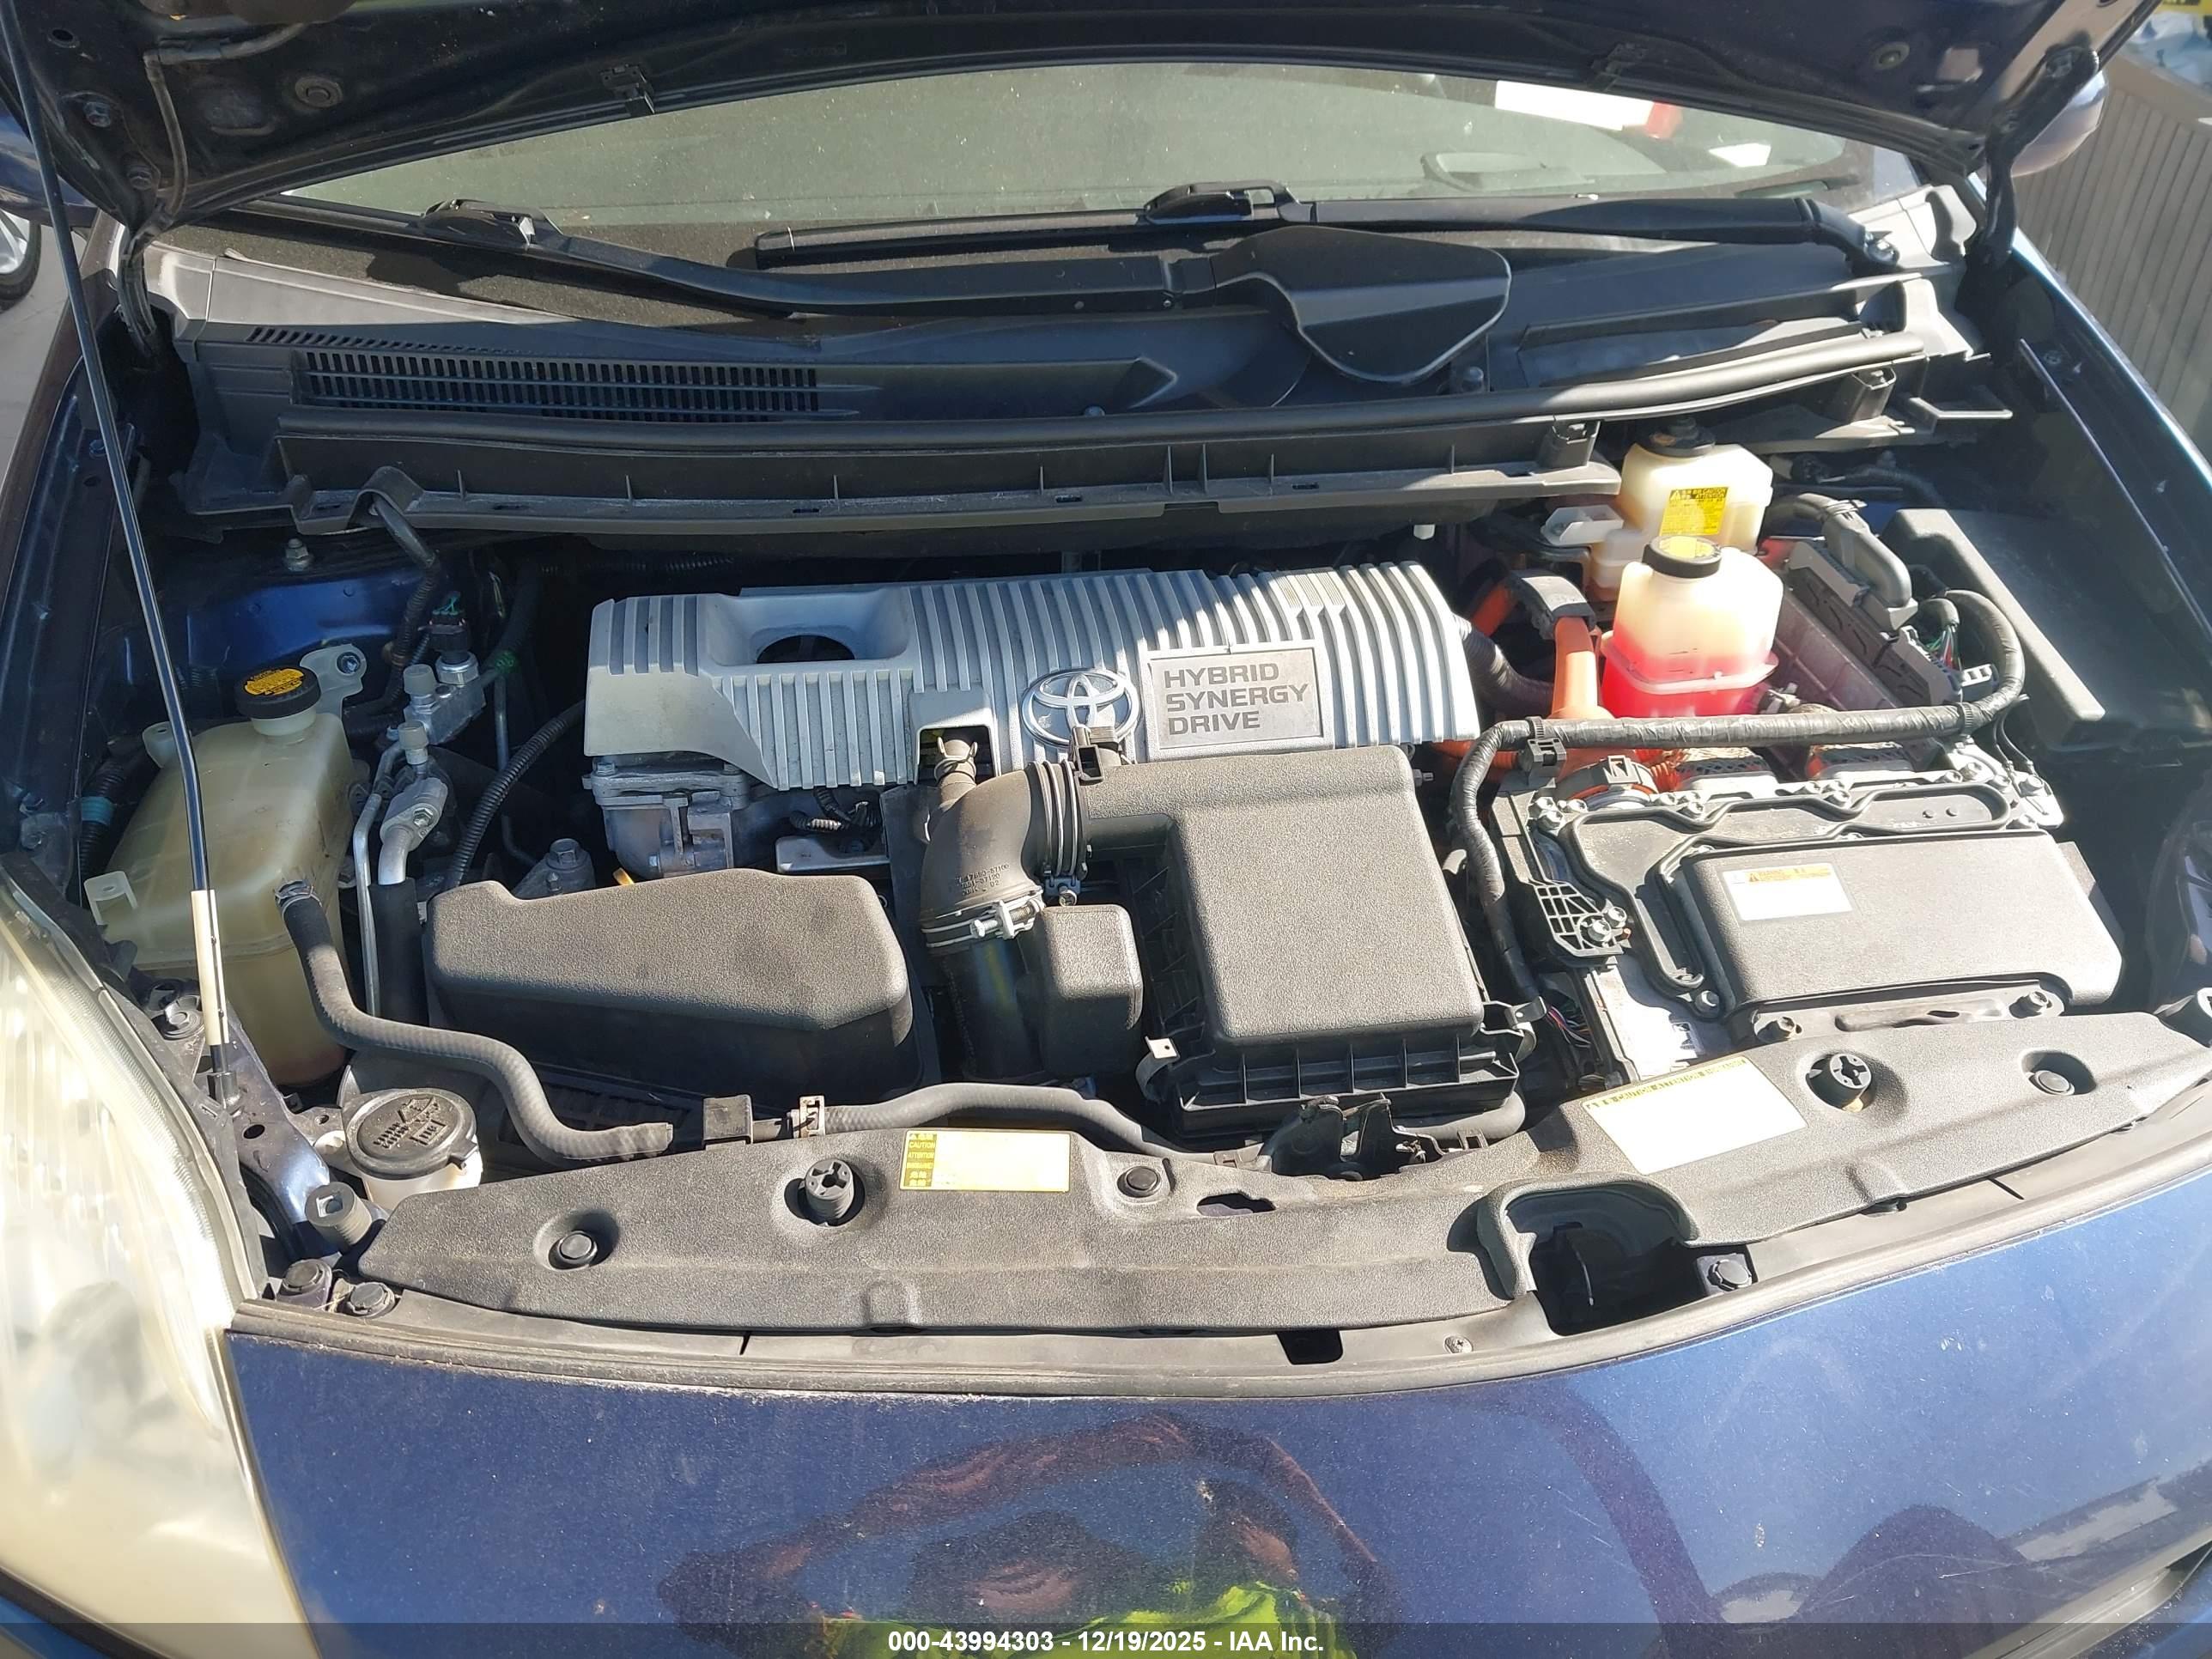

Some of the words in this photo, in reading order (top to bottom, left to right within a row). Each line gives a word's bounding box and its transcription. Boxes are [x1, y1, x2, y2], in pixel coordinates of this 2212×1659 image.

[1164, 662, 1279, 689] HYBRID
[1166, 683, 1309, 713] SYNERGY
[1169, 710, 1261, 735] DRIVE
[908, 1140, 936, 1149] CAUTION
